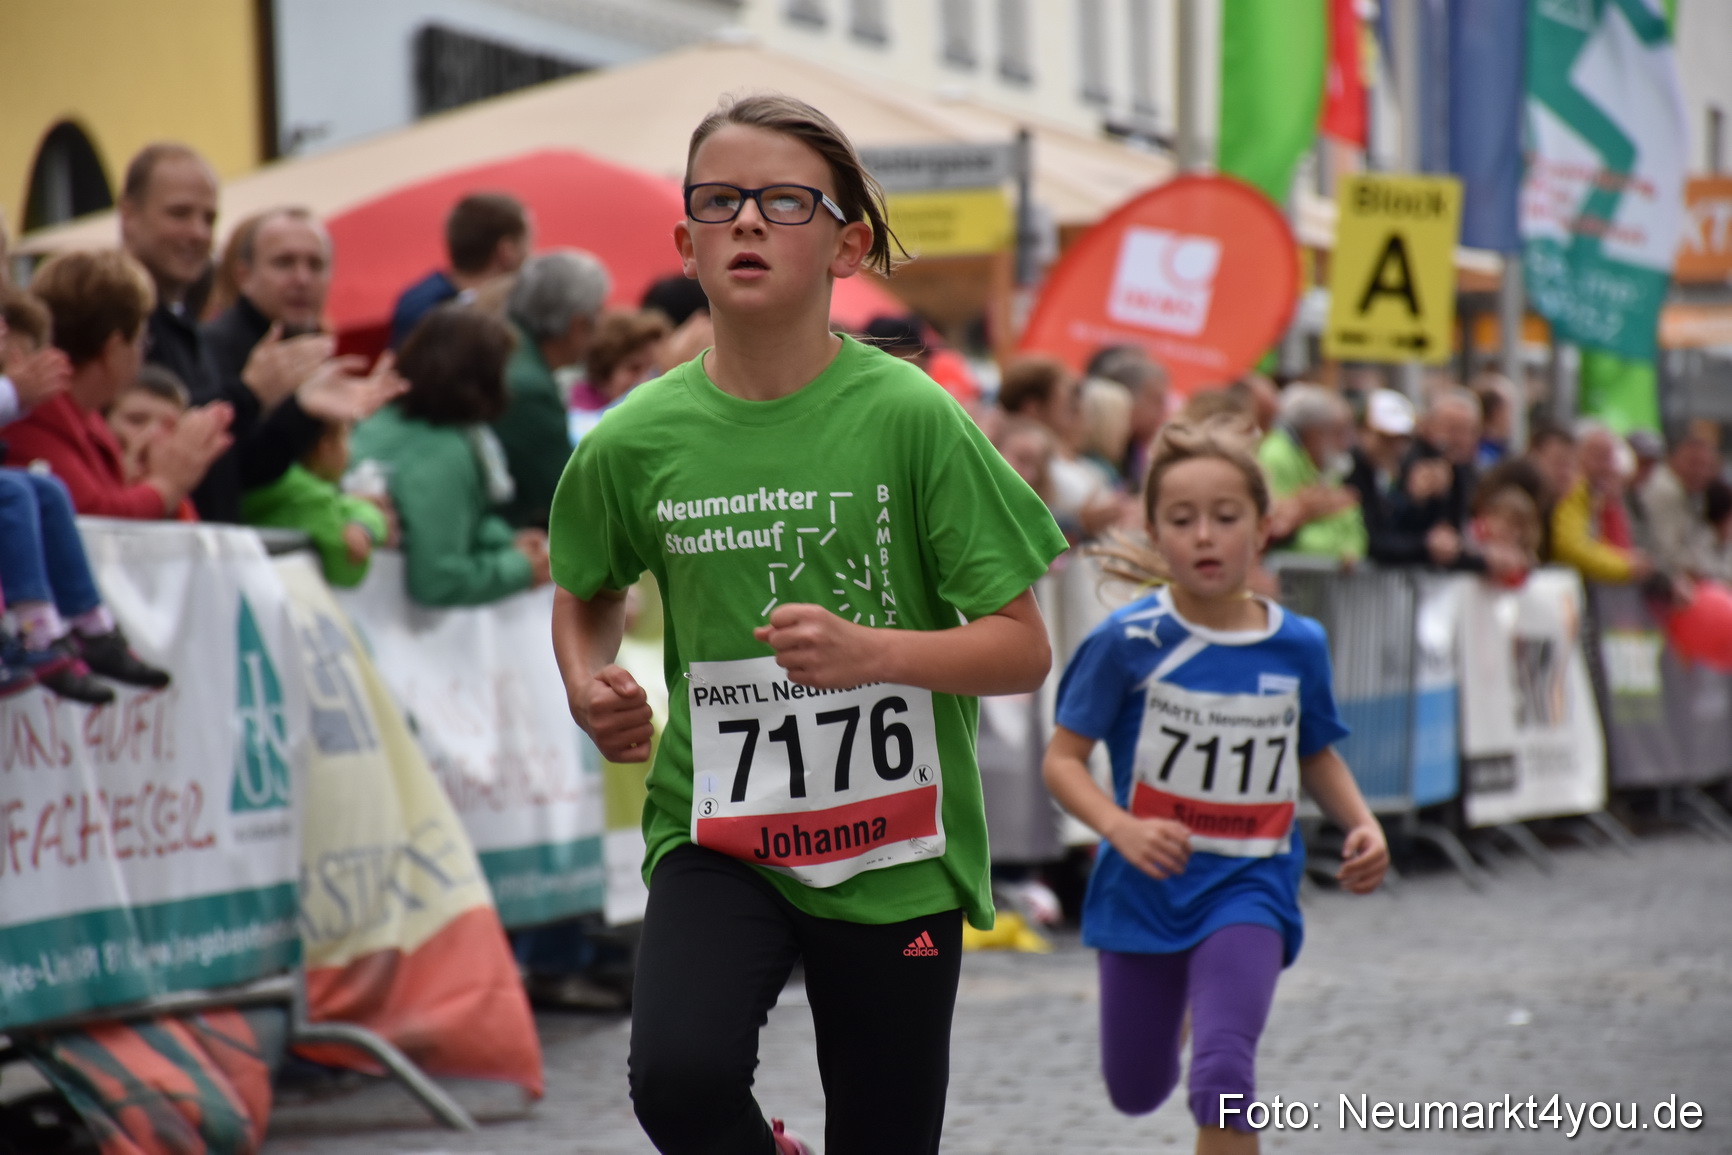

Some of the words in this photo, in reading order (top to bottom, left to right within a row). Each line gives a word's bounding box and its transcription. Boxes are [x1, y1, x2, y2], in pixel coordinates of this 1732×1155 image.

[1353, 182, 1447, 220] Block
[1357, 231, 1423, 319] A
[656, 487, 818, 522] Neumarkter
[664, 521, 786, 555] Stadtlauf
[875, 484, 897, 625] BAMBINI
[693, 682, 769, 707] PARTL
[718, 694, 915, 804] 7176
[1158, 725, 1287, 795] 7117
[917, 767, 929, 783] K
[703, 800, 713, 815] 3
[754, 815, 888, 860] Johanna
[902, 946, 939, 957] adidas
